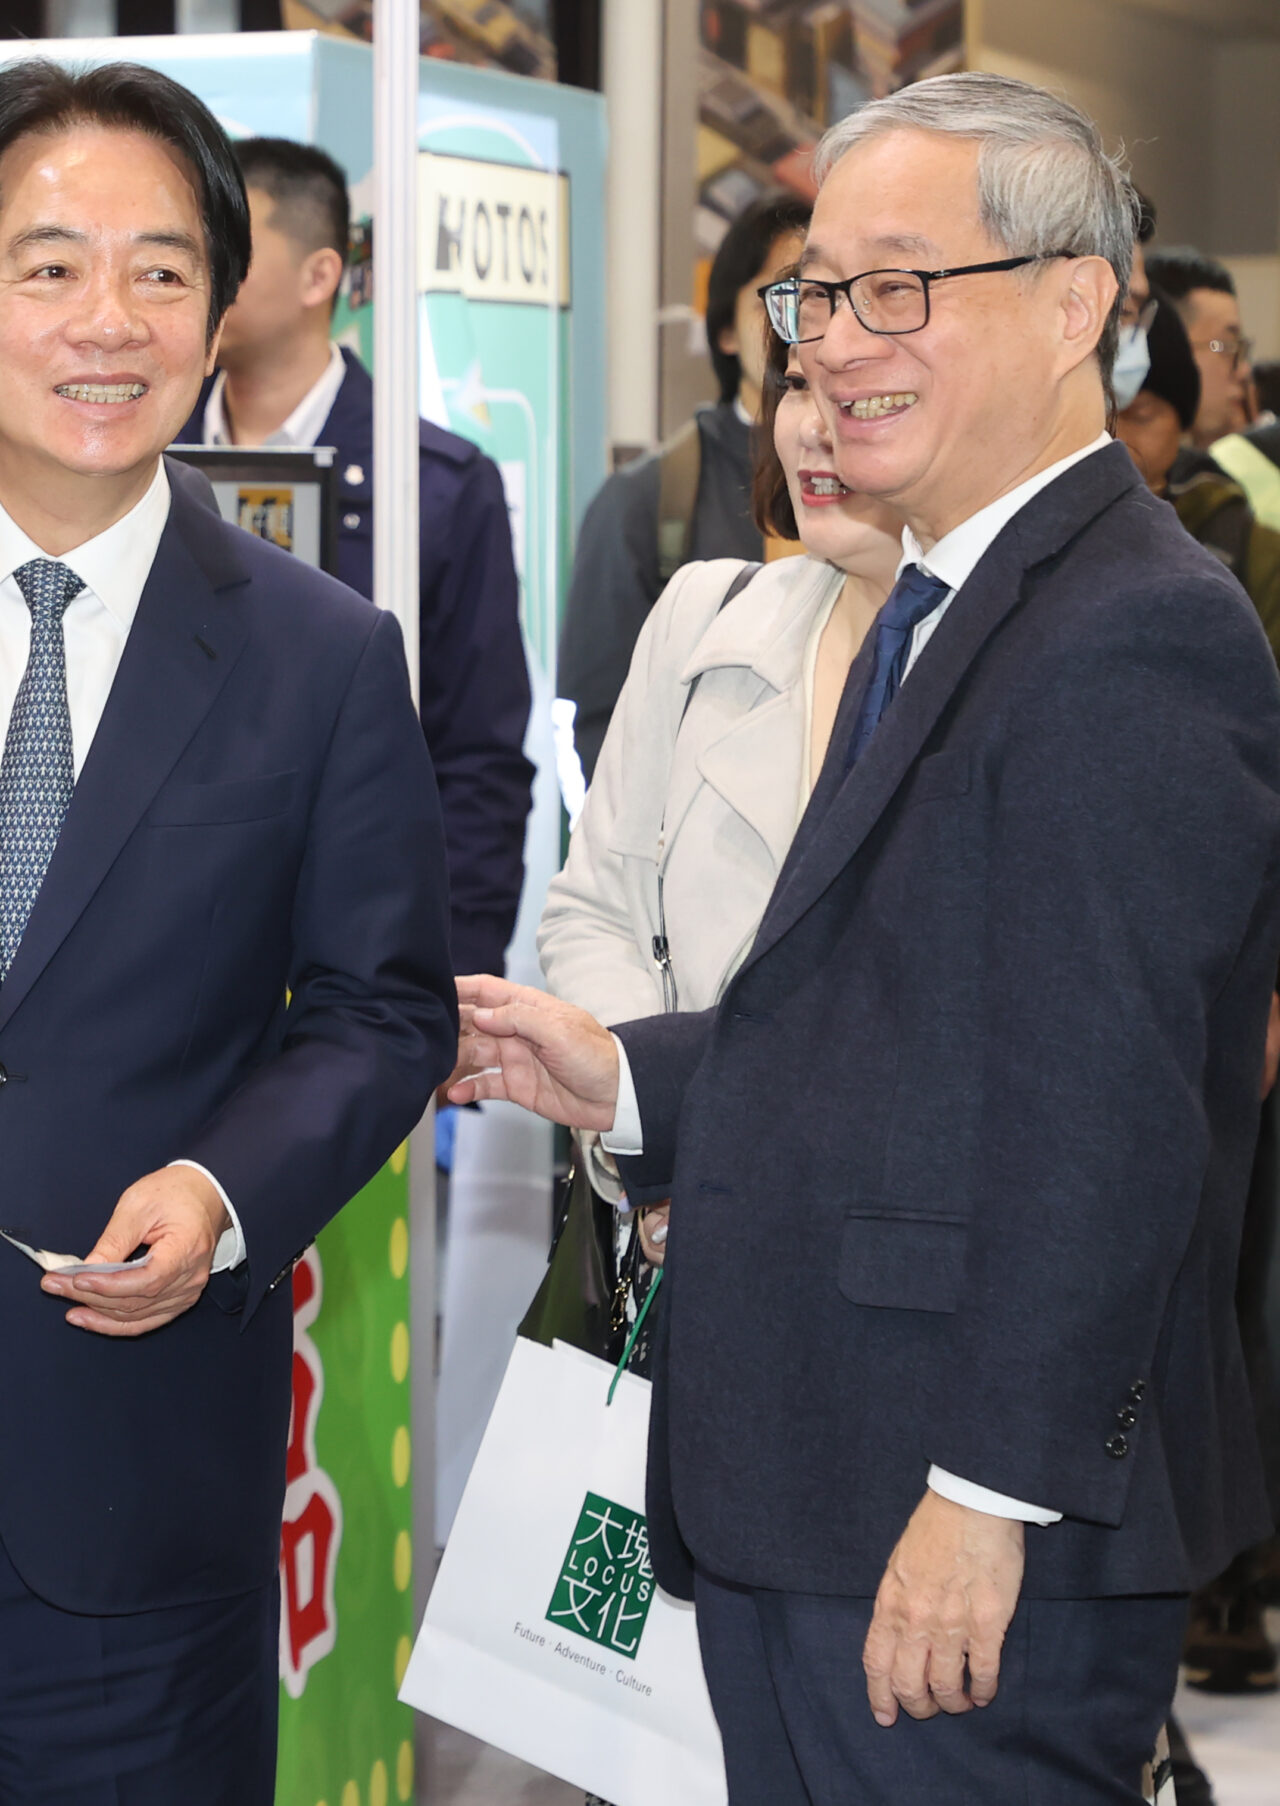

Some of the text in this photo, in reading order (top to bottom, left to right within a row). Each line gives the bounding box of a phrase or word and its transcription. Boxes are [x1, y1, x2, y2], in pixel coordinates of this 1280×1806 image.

[568, 1549, 652, 1601] LOCUS
[575, 1506, 654, 1579] 大塊
[550, 1578, 643, 1652] 文化
[513, 1621, 653, 1697] Future Adventure Culture
